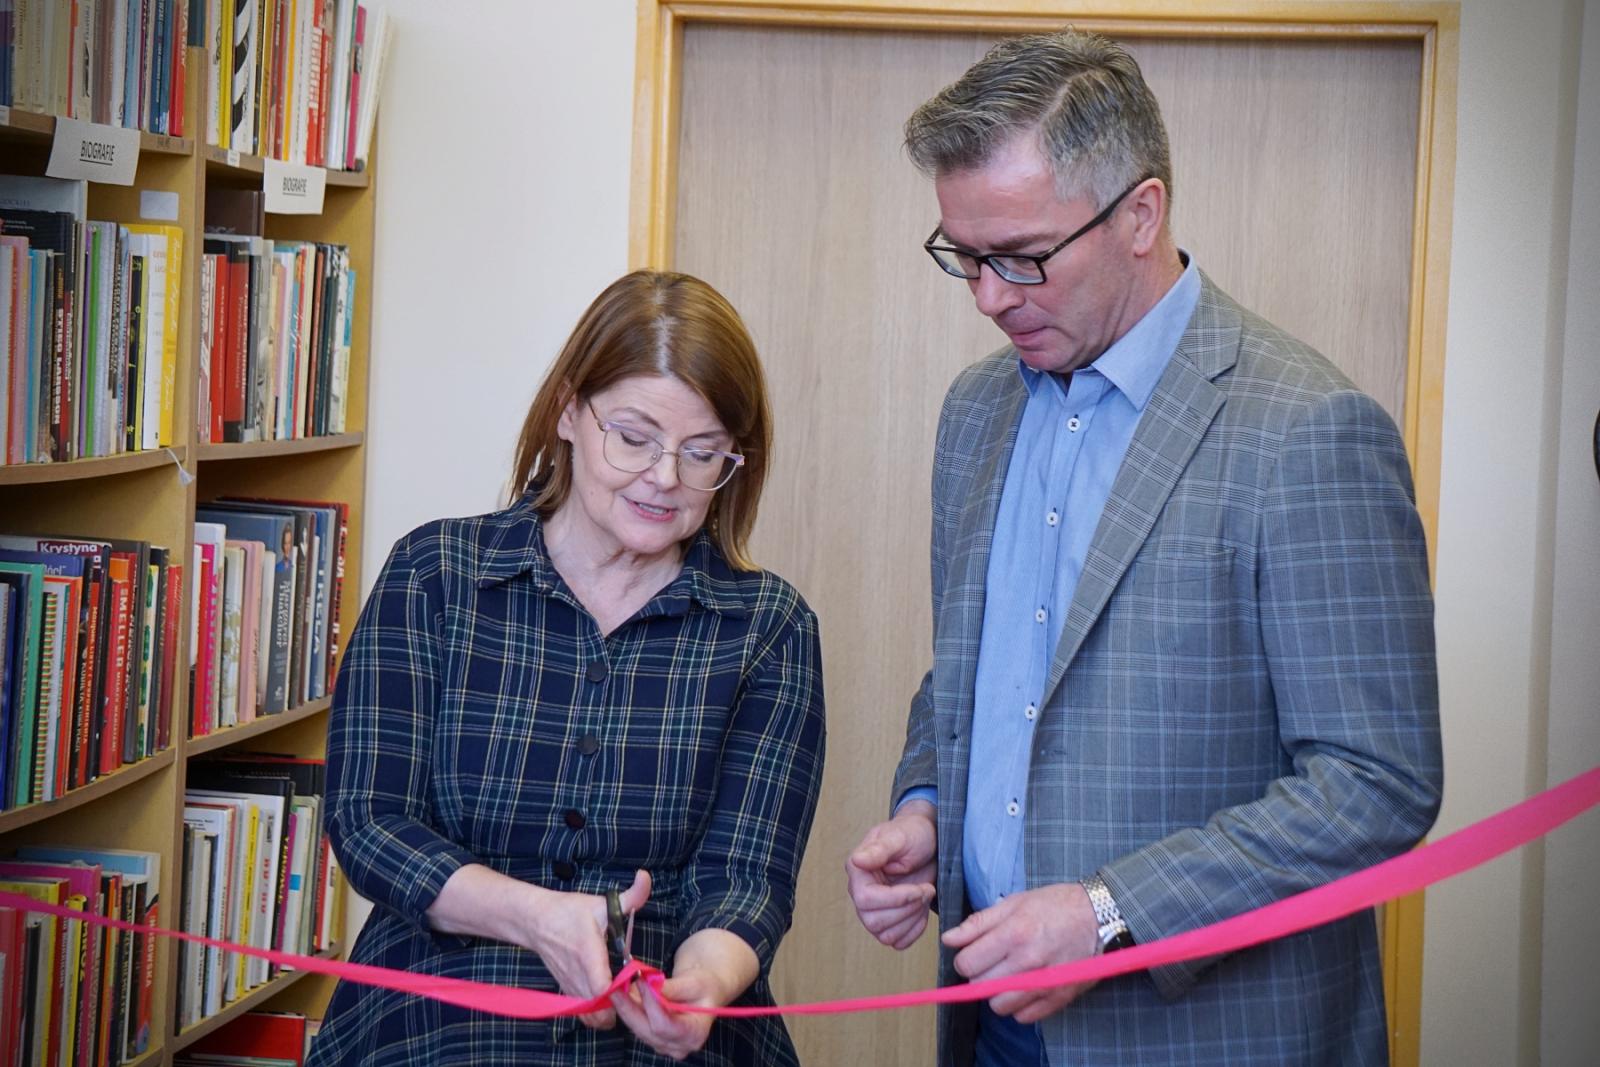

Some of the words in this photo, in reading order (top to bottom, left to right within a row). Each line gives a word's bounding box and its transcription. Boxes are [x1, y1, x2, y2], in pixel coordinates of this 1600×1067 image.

[80, 140, 115, 161] BIOGRAFIE
[282, 176, 307, 192] BIOGRAFIE
[54, 356, 63, 425] LARSSON
[40, 543, 97, 555] Krystyna
[116, 596, 127, 667] MELLER
